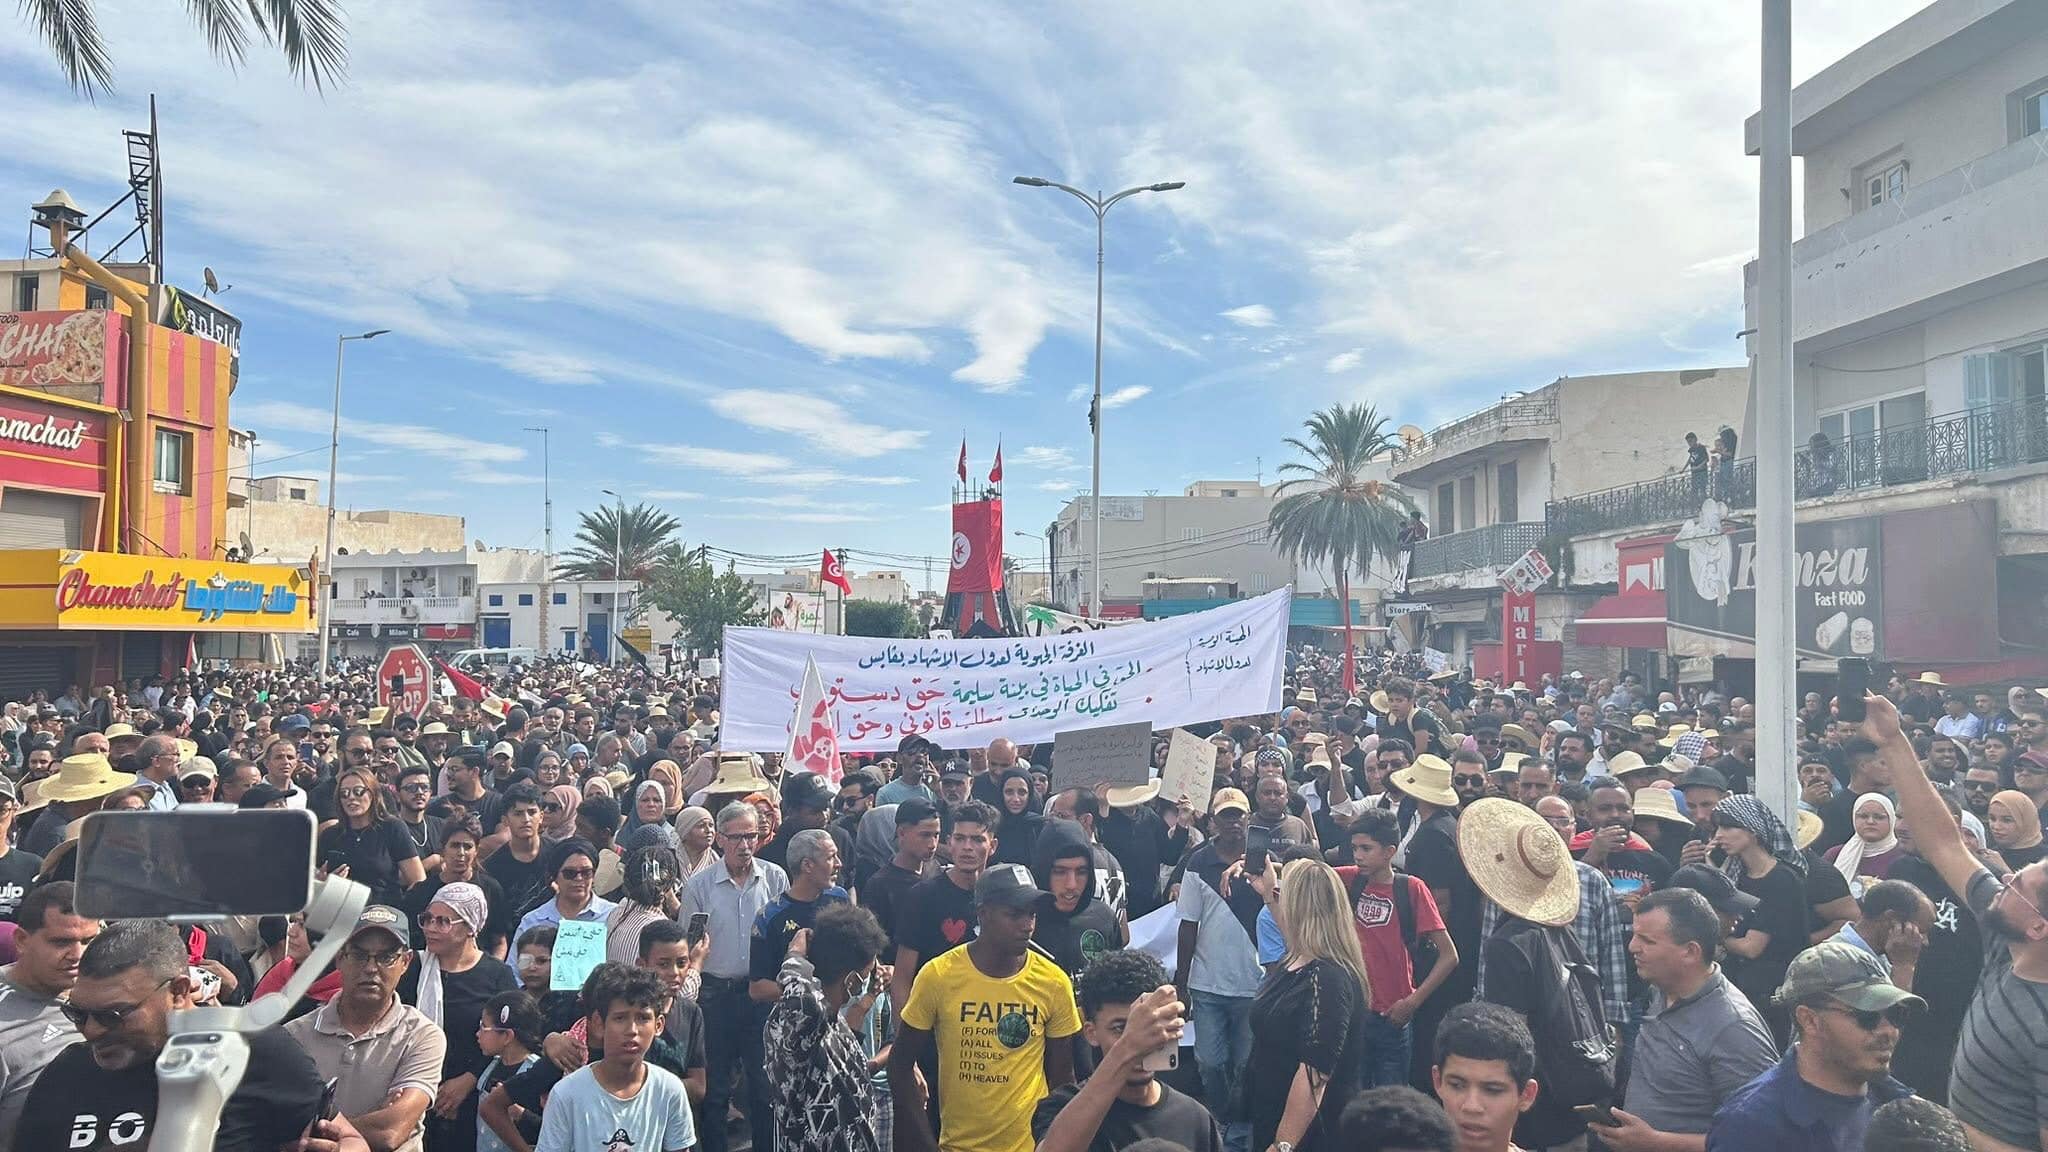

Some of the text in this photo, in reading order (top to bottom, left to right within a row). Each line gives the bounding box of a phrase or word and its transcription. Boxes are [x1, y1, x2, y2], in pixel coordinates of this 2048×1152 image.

[1732, 542, 1869, 591] Knza
[56, 568, 184, 612] Chamchat
[1814, 590, 1866, 607] Fast FOOD
[1389, 606, 1410, 614] Store
[858, 644, 905, 669] بقابس
[1015, 644, 1056, 667] الجهوية
[1058, 640, 1094, 662] الغرفة
[1053, 669, 1088, 696] الحياة
[1075, 688, 1117, 715] تفكيك
[960, 1001, 1038, 1024] FAITH
[961, 1026, 974, 1037] (F)
[960, 1039, 974, 1048] (A)
[975, 1040, 993, 1048] ALL
[960, 1060, 985, 1071] (T) TO
[974, 1051, 1004, 1060] ISSUES
[959, 1072, 1009, 1083] (H) HEAVEN
